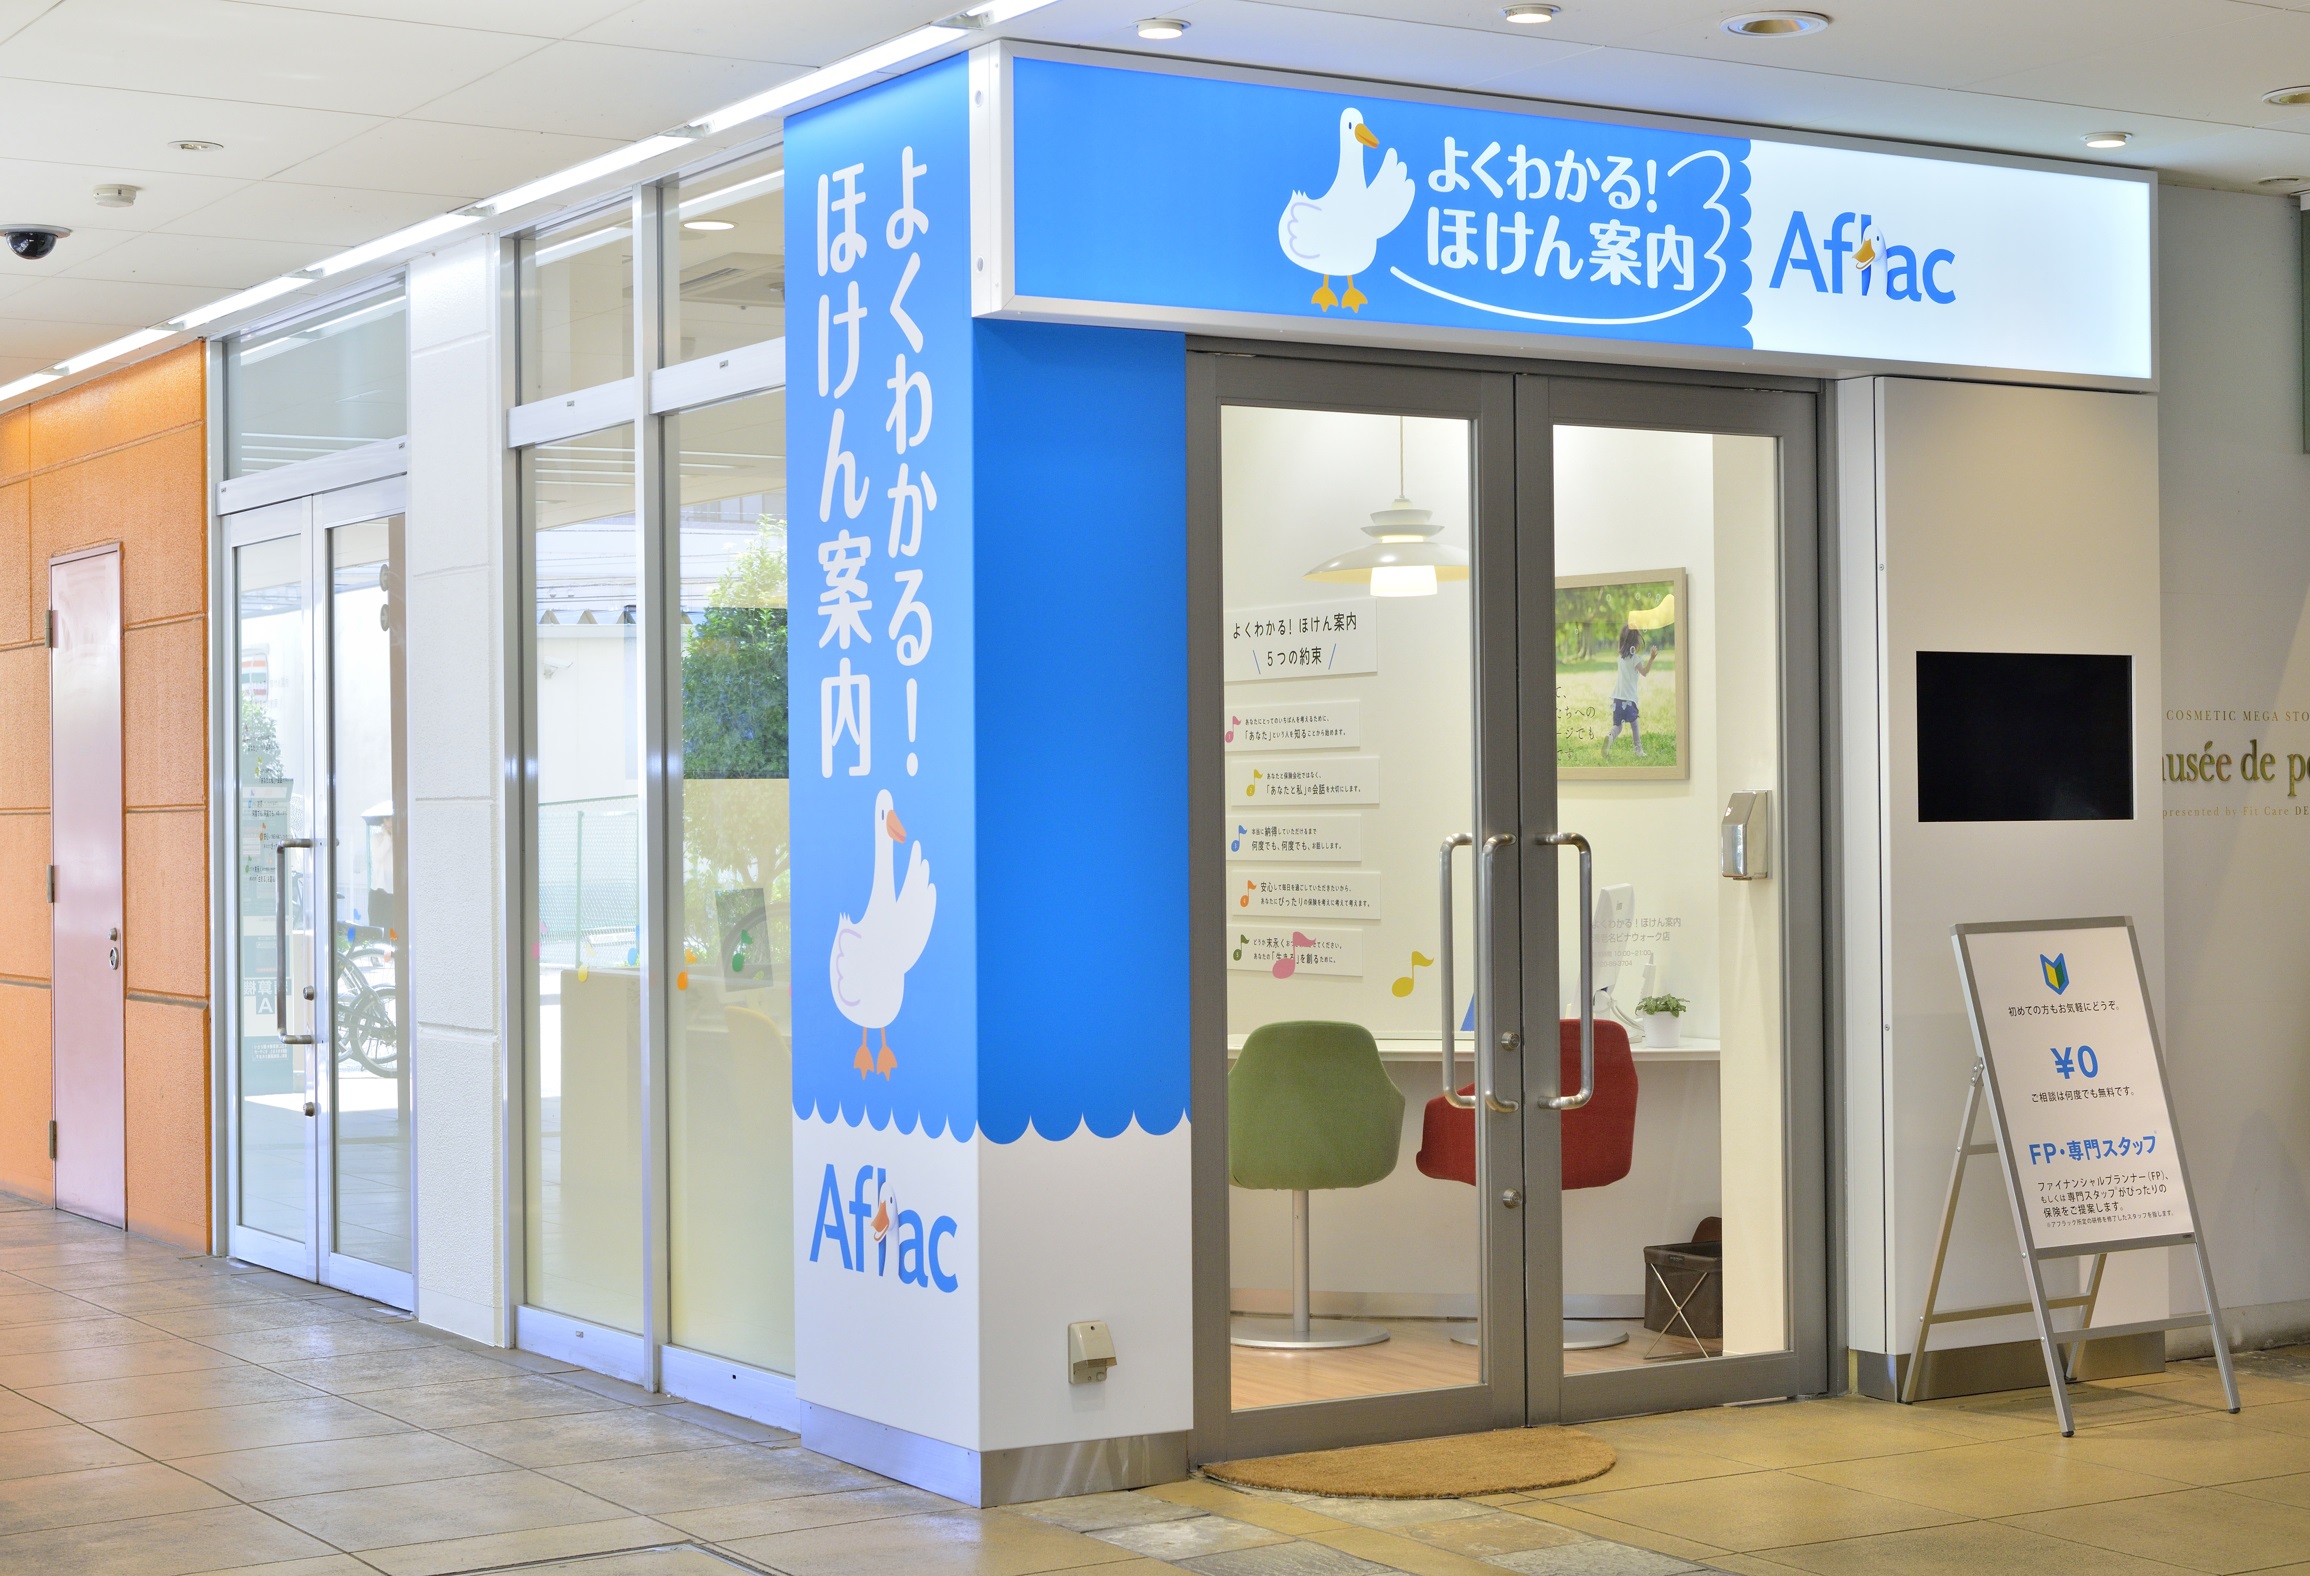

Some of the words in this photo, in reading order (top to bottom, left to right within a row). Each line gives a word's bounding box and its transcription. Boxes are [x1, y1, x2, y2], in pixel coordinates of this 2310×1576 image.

[1425, 136, 1659, 213] よくわかる！
[1426, 204, 1697, 292] ほけん案内
[1769, 210, 1957, 305] Aflac
[816, 161, 873, 779] ほけん案内
[885, 145, 939, 778] よくわかる！
[1267, 646, 1323, 667] 5つの約束
[2166, 709, 2236, 721] COSMETIC
[2243, 710, 2280, 722] MEGA
[2162, 740, 2232, 782] usée
[2240, 738, 2276, 782] de
[2287, 753, 2310, 798] p
[2162, 807, 2219, 819] presented
[2225, 806, 2237, 818] by
[2243, 806, 2259, 816] Fit
[2264, 807, 2289, 816] Care
[1253, 937, 1342, 950] どうか末永くおてください。
[2008, 1000, 2120, 1017] 初めての方もお気軽にどうぞ。
[2050, 1045, 2099, 1079] ¥0
[2031, 1085, 2136, 1103] ご相談は何度でも無料です。
[2043, 1200, 2124, 1219] 保険をご提案します。
[809, 1163, 959, 1294] Aflac
